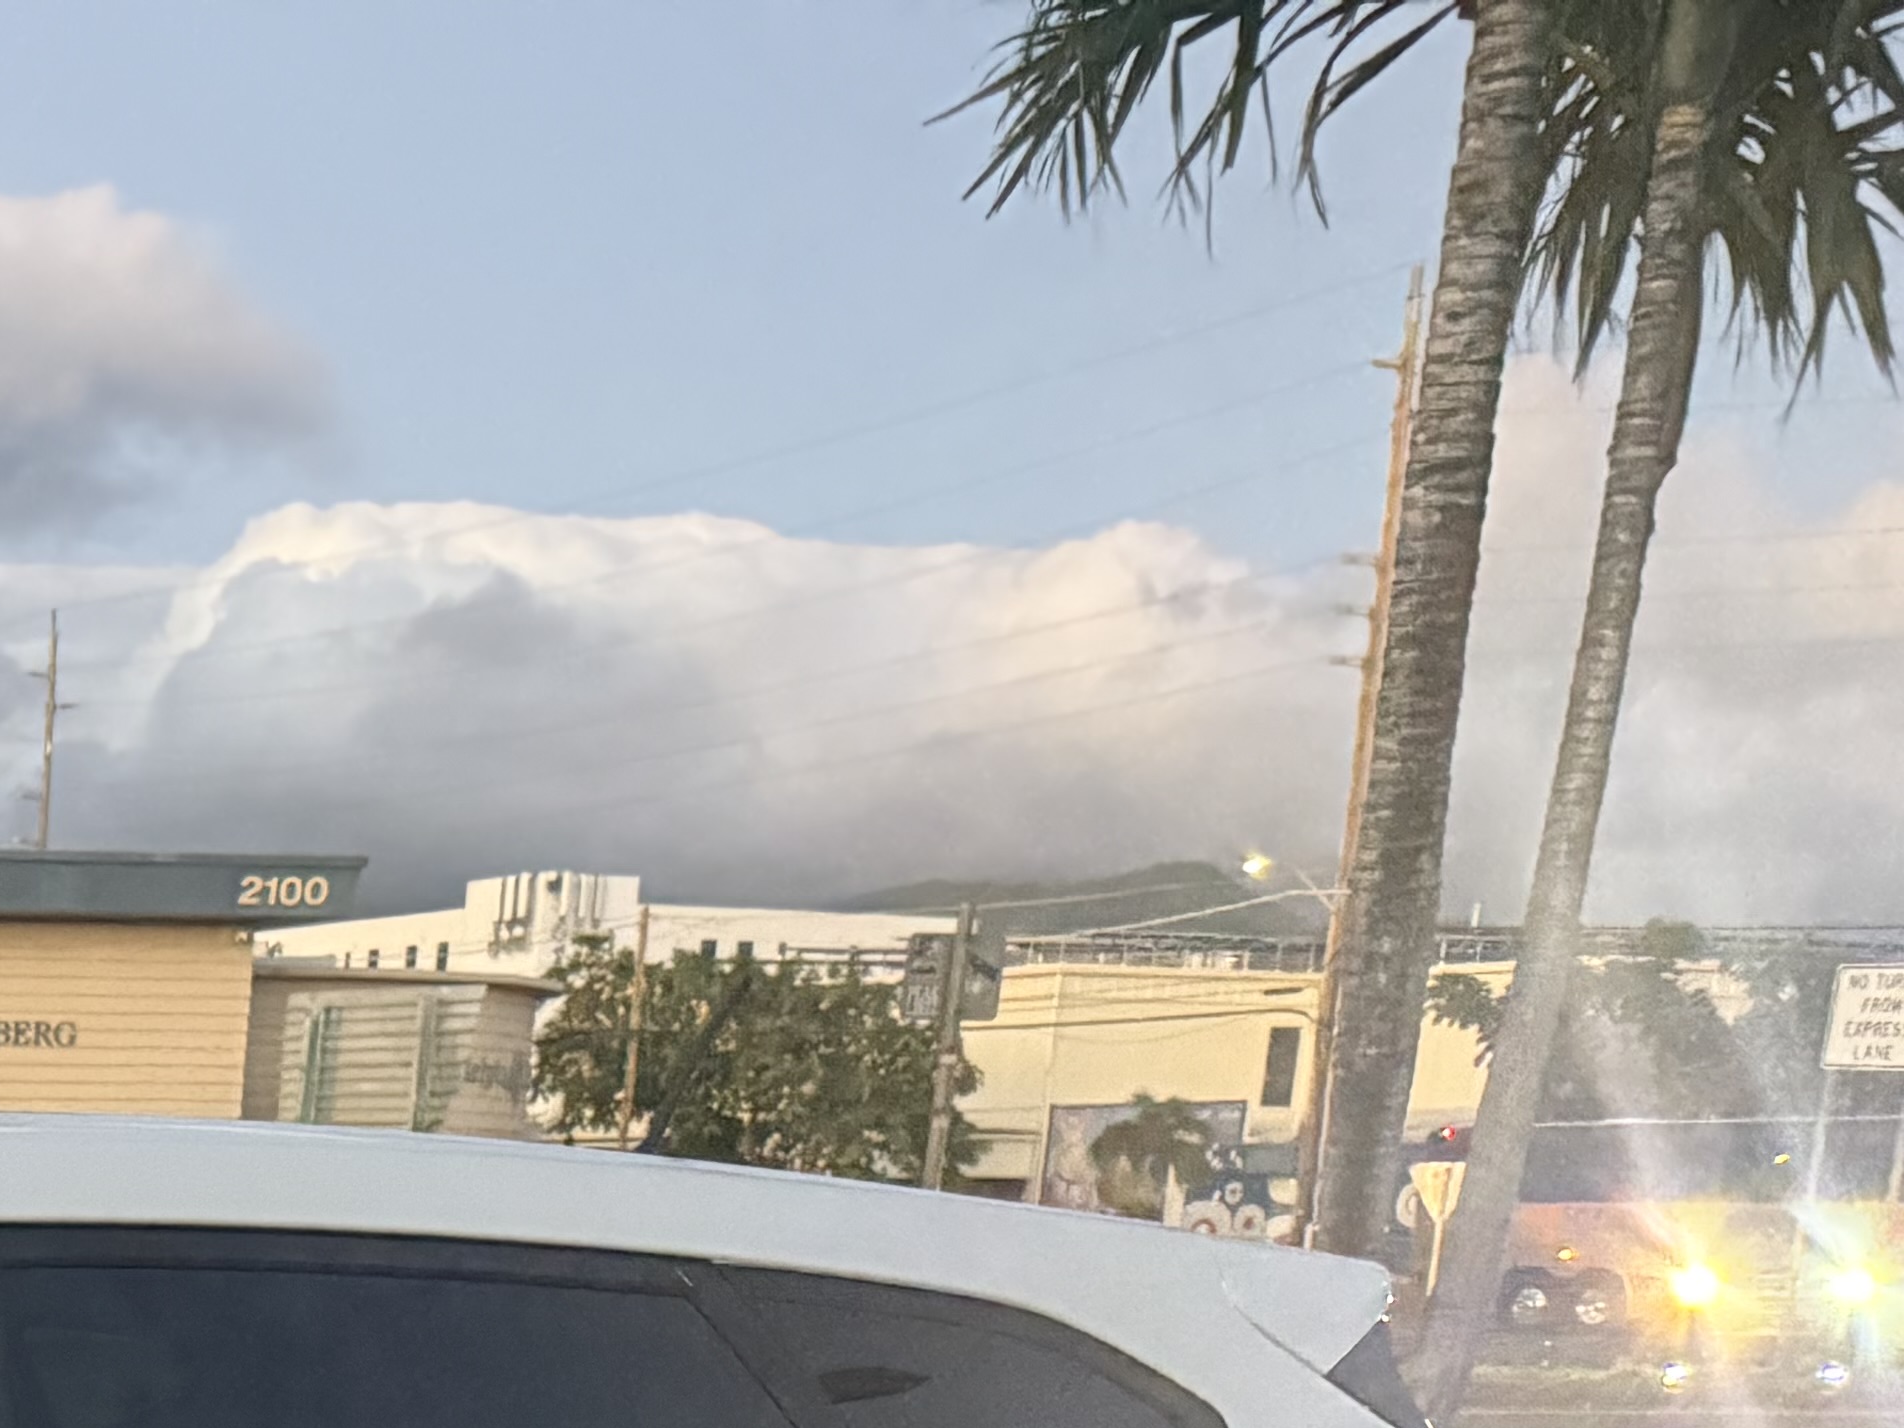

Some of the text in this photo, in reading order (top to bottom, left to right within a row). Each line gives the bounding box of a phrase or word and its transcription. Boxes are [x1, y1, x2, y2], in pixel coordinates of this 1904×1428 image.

[237, 876, 329, 906] 2100
[1843, 1021, 1904, 1038] EXPRES
[1853, 1045, 1894, 1061] LANE
